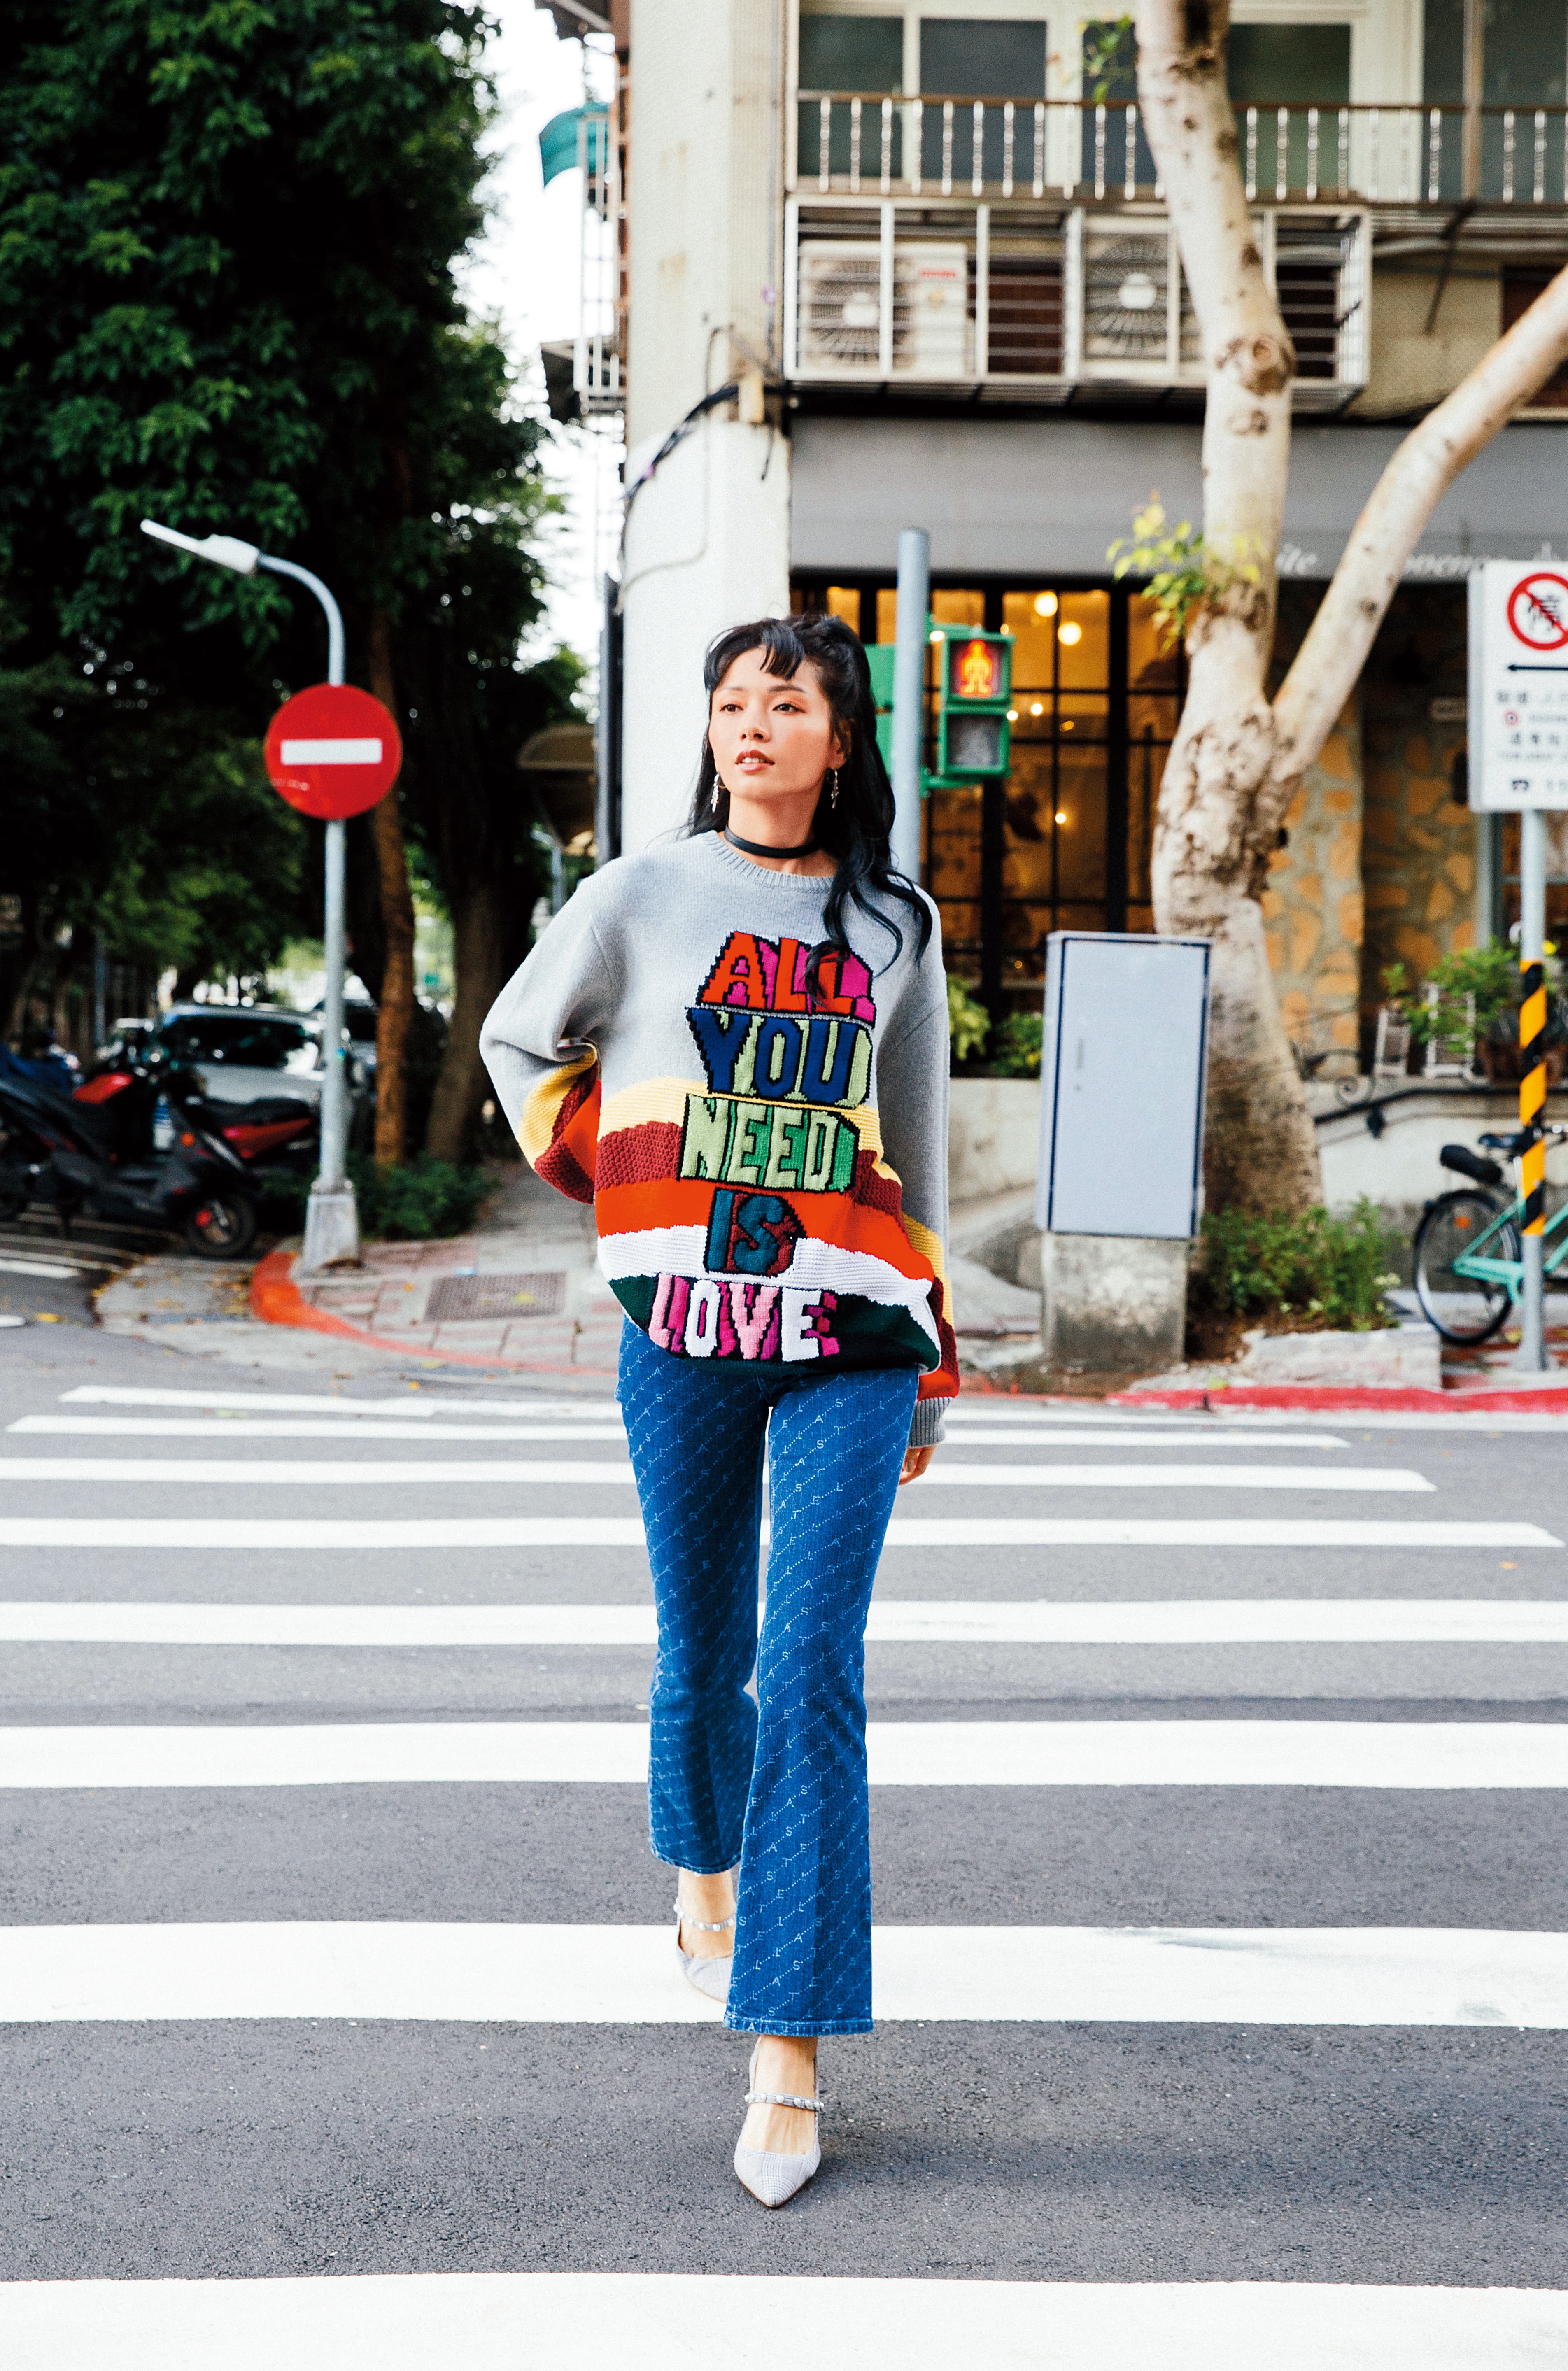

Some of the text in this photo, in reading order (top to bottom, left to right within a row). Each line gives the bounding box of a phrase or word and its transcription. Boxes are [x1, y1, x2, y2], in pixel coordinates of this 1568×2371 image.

[697, 931, 875, 1026] ALL
[685, 1007, 873, 1109] YOU
[679, 1093, 860, 1193] NEED
[704, 1188, 807, 1275] IS
[649, 1273, 840, 1362] LOVE
